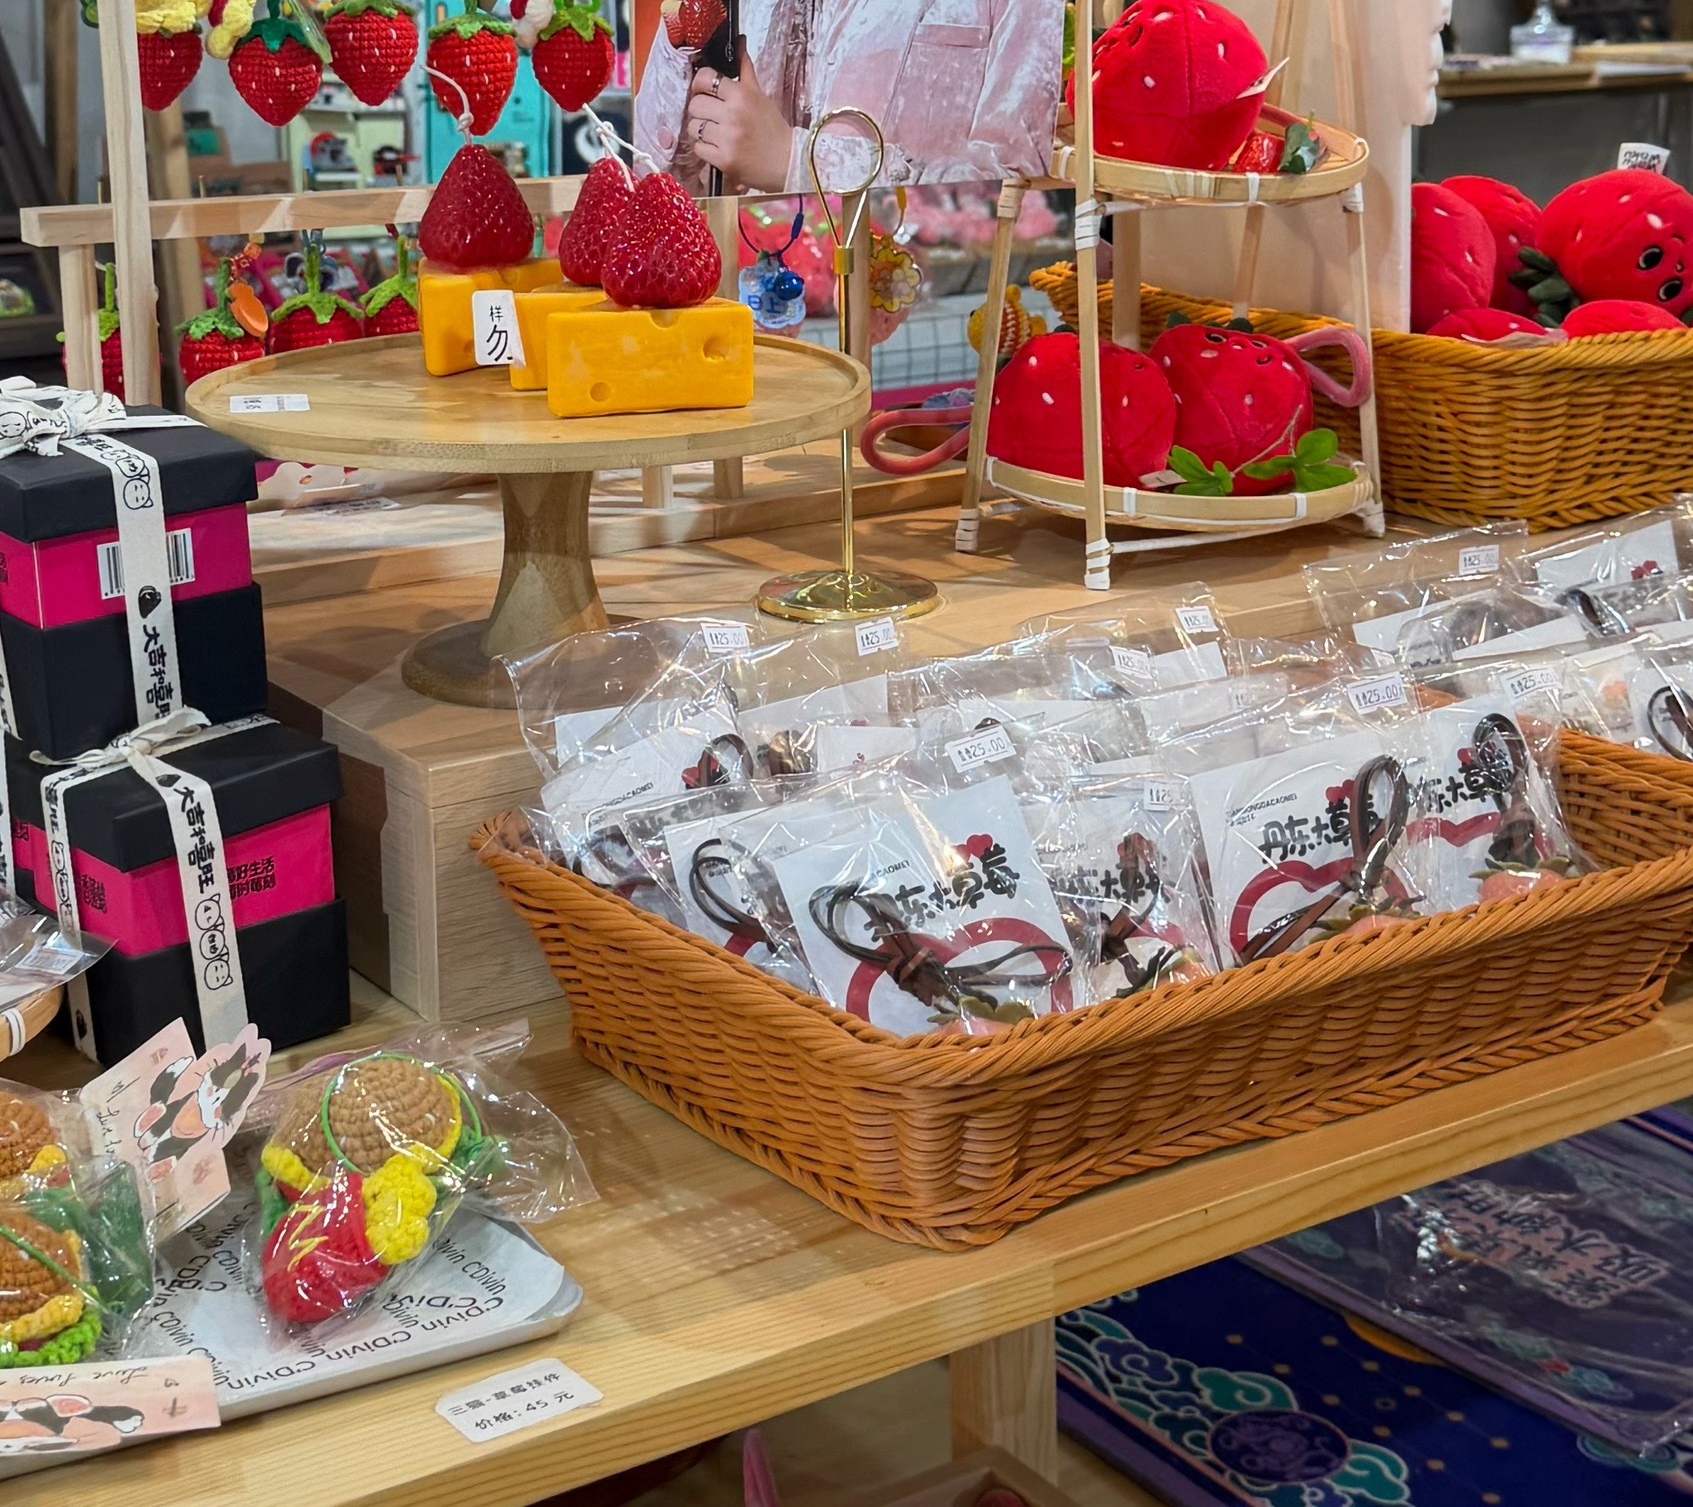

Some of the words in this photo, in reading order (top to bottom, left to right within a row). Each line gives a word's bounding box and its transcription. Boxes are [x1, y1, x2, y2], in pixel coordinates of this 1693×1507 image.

[173, 785, 216, 894] 大吉和喜旺
